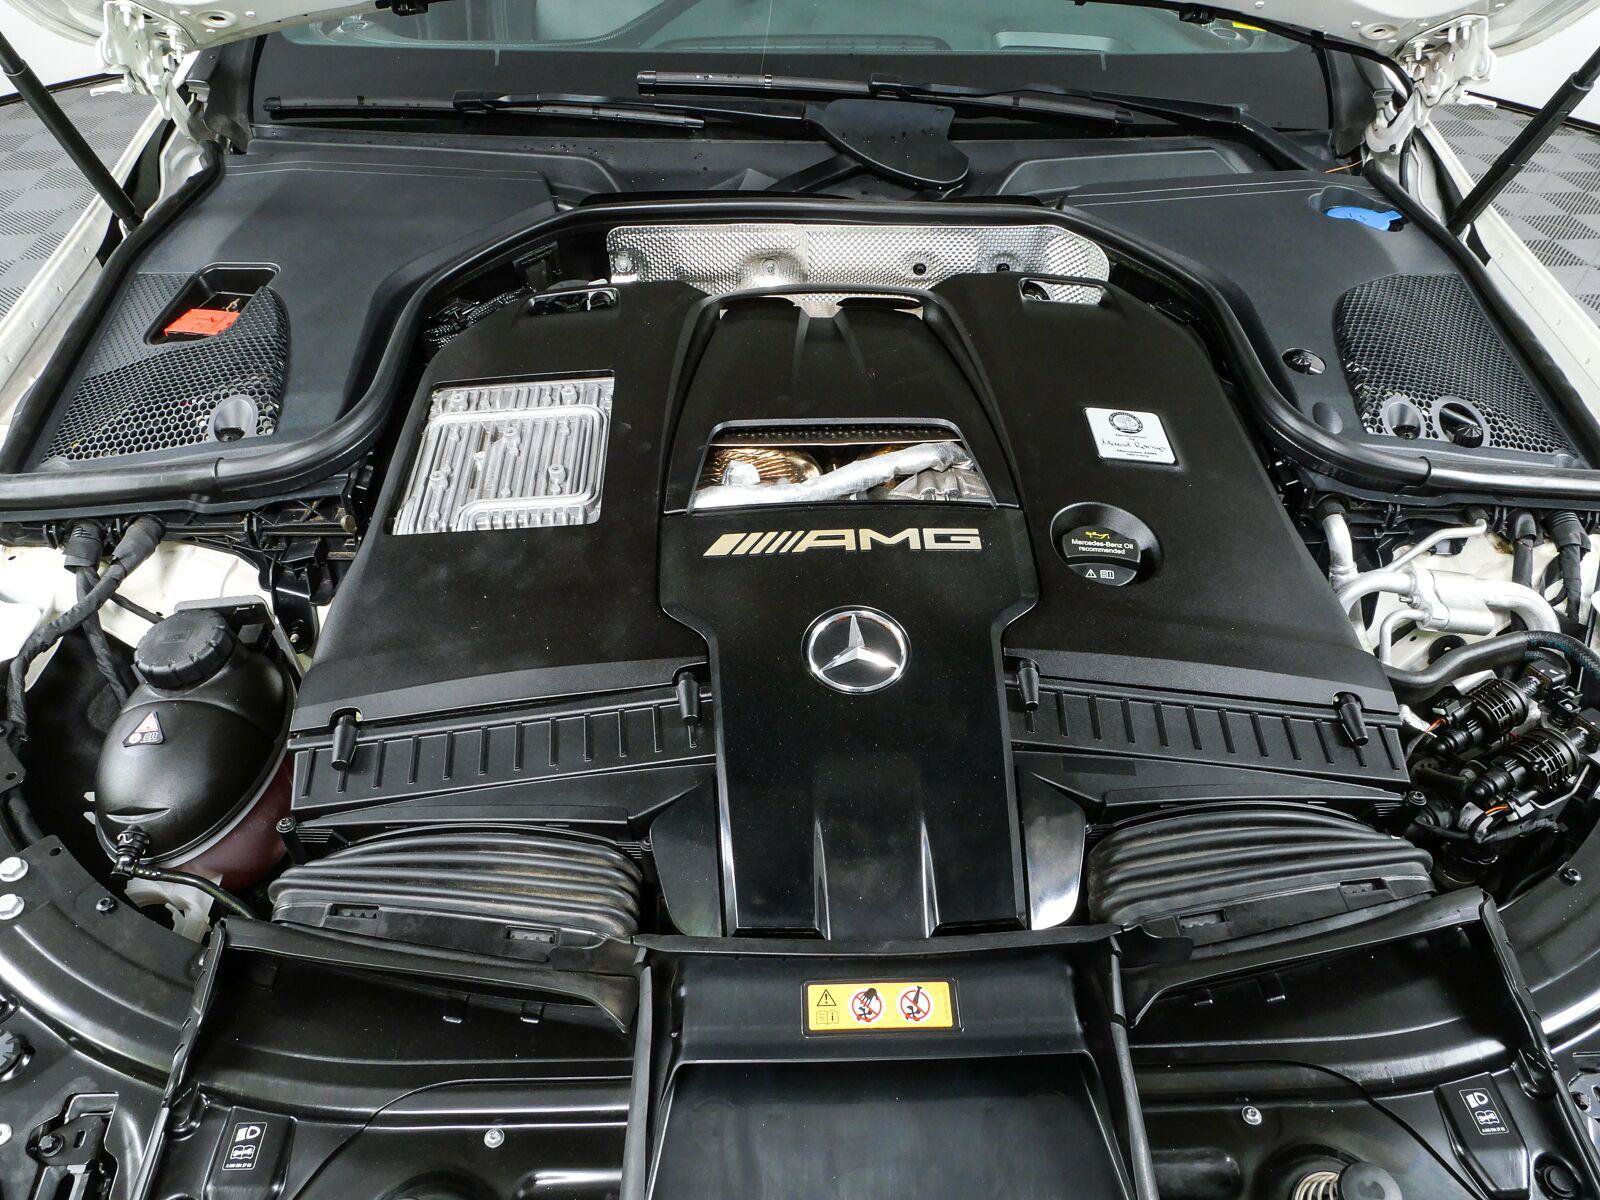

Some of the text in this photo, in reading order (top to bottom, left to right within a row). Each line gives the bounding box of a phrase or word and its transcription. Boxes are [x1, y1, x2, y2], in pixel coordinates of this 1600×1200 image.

[792, 528, 982, 553] AMG
[1071, 539, 1134, 550] Mercedes-Benz Oil
[1078, 546, 1126, 555] recommended
